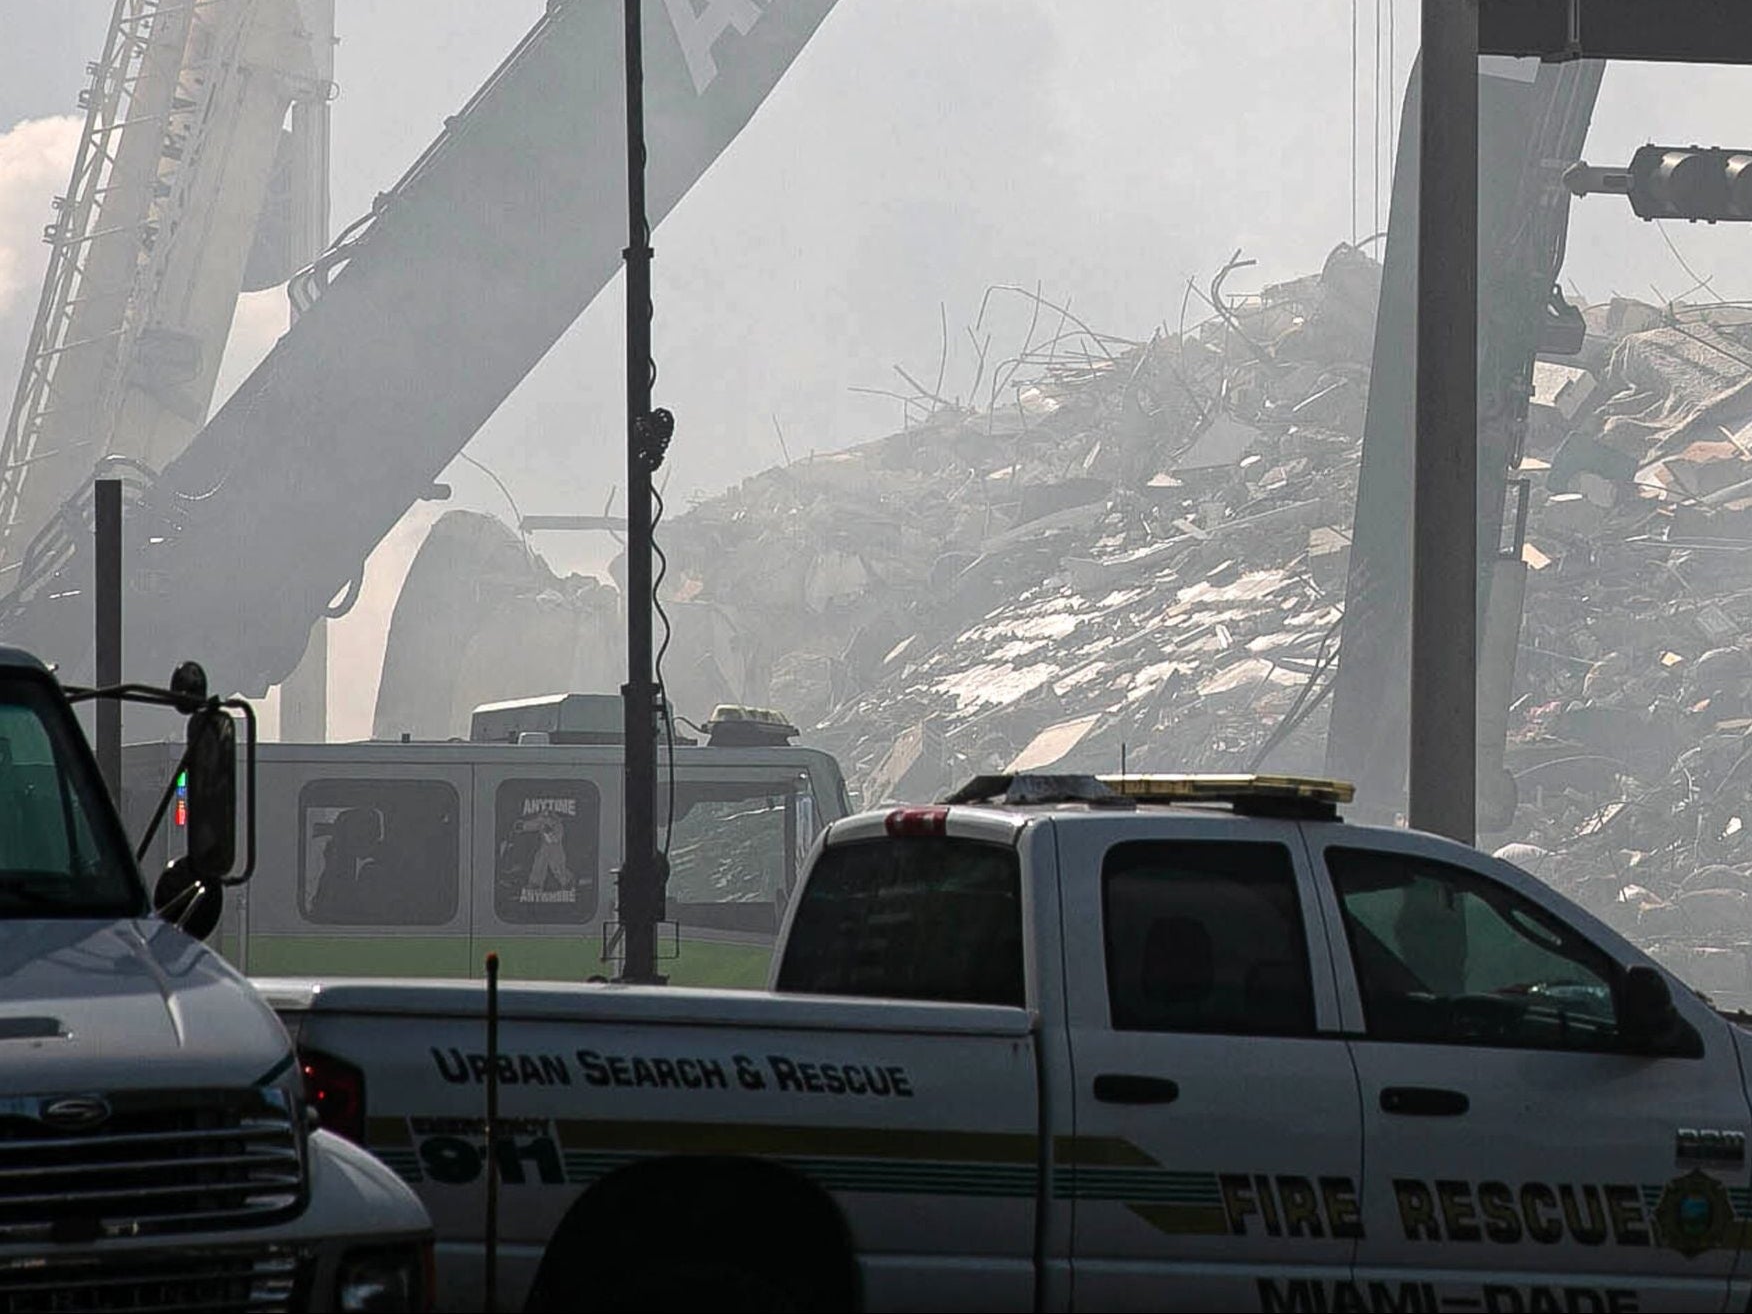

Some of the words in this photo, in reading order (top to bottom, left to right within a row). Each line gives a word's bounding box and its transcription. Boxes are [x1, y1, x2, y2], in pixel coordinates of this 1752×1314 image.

[522, 797, 577, 817] ANYTIME
[430, 1046, 571, 1085] URBAN
[576, 1048, 728, 1090] SEARCH
[732, 1054, 765, 1091] &
[766, 1054, 914, 1098] RESCUE
[1219, 1174, 1366, 1239] FIRE
[1392, 1179, 1653, 1247] RESCUE
